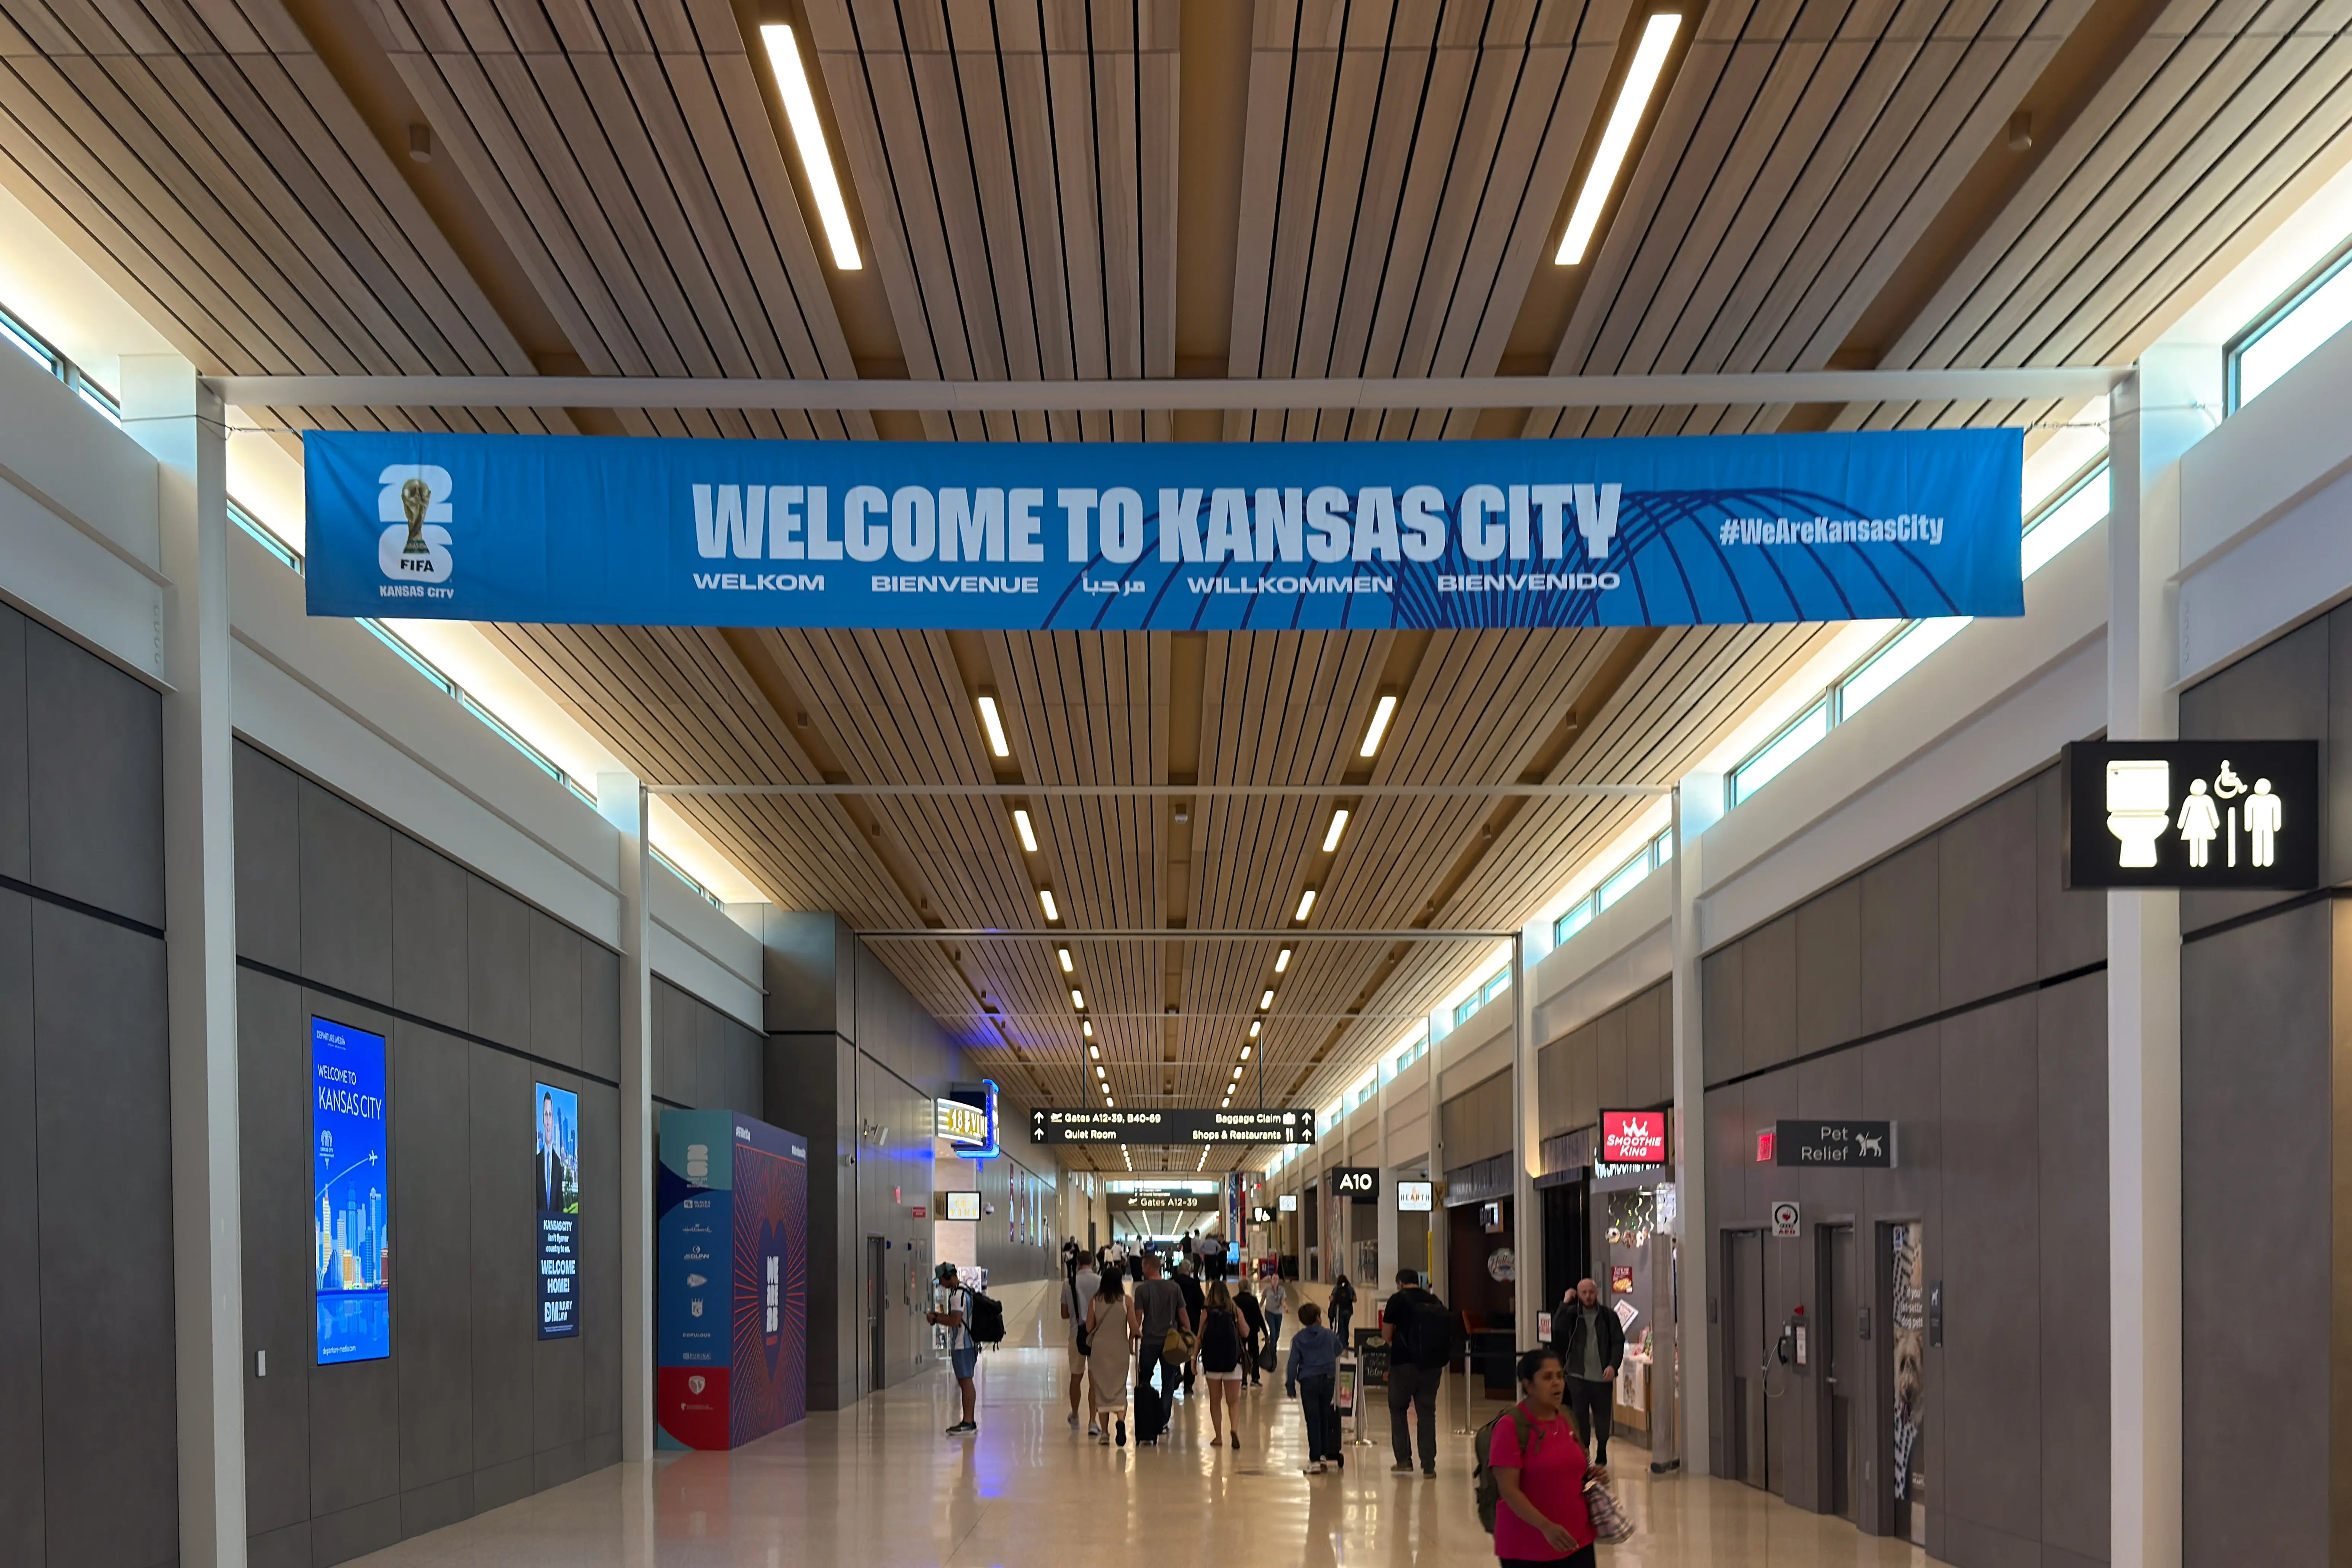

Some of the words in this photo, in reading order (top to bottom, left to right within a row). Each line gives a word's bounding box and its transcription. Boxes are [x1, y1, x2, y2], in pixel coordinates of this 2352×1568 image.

[692, 484, 1044, 562] WELCOME
[1058, 487, 1143, 563] TO
[1159, 486, 1445, 562] KANSAS
[1461, 483, 1622, 561] CITY
[1719, 514, 1943, 545] #WeAreKansasCity
[401, 559, 434, 572] FIFA
[693, 573, 824, 591] WELKOM
[872, 575, 1039, 593] BIENVENUE
[1187, 575, 1393, 594] WILLKOMMEN
[1438, 572, 1621, 592] BIENVENIDO
[379, 585, 424, 598] KANSAS
[427, 586, 454, 599] CITY
[317, 1030, 335, 1043] DEPARTURE
[317, 1064, 347, 1084] WELCOME
[348, 1071, 357, 1085] TO
[319, 1086, 359, 1116] KANSAS
[360, 1095, 382, 1120] CITY
[951, 1109, 963, 1129] 18
[1064, 1113, 1090, 1123] Gates
[1092, 1114, 1125, 1124] A12-39,
[1216, 1114, 1255, 1125] Baggage
[1256, 1114, 1281, 1123] Claim
[1064, 1129, 1088, 1139] Quiet
[1090, 1130, 1116, 1139] Room
[1192, 1130, 1219, 1141] Shops
[1221, 1130, 1228, 1140] &
[1230, 1130, 1281, 1140] Restaurants
[1606, 1134, 1662, 1147] SMOOTHIE
[1821, 1126, 1848, 1141] Pet
[1620, 1145, 1647, 1157] KING
[1801, 1145, 1848, 1161] Relief
[1339, 1173, 1372, 1190] A10
[1141, 1198, 1165, 1207] Gates
[1167, 1198, 1198, 1207] A12-39
[543, 1220, 562, 1231] KANSAS
[562, 1221, 572, 1232] CITY
[541, 1259, 575, 1275] WELCOME
[767, 1256, 779, 1284] WE
[547, 1278, 570, 1294] HOME!
[558, 1311, 568, 1321] LAW
